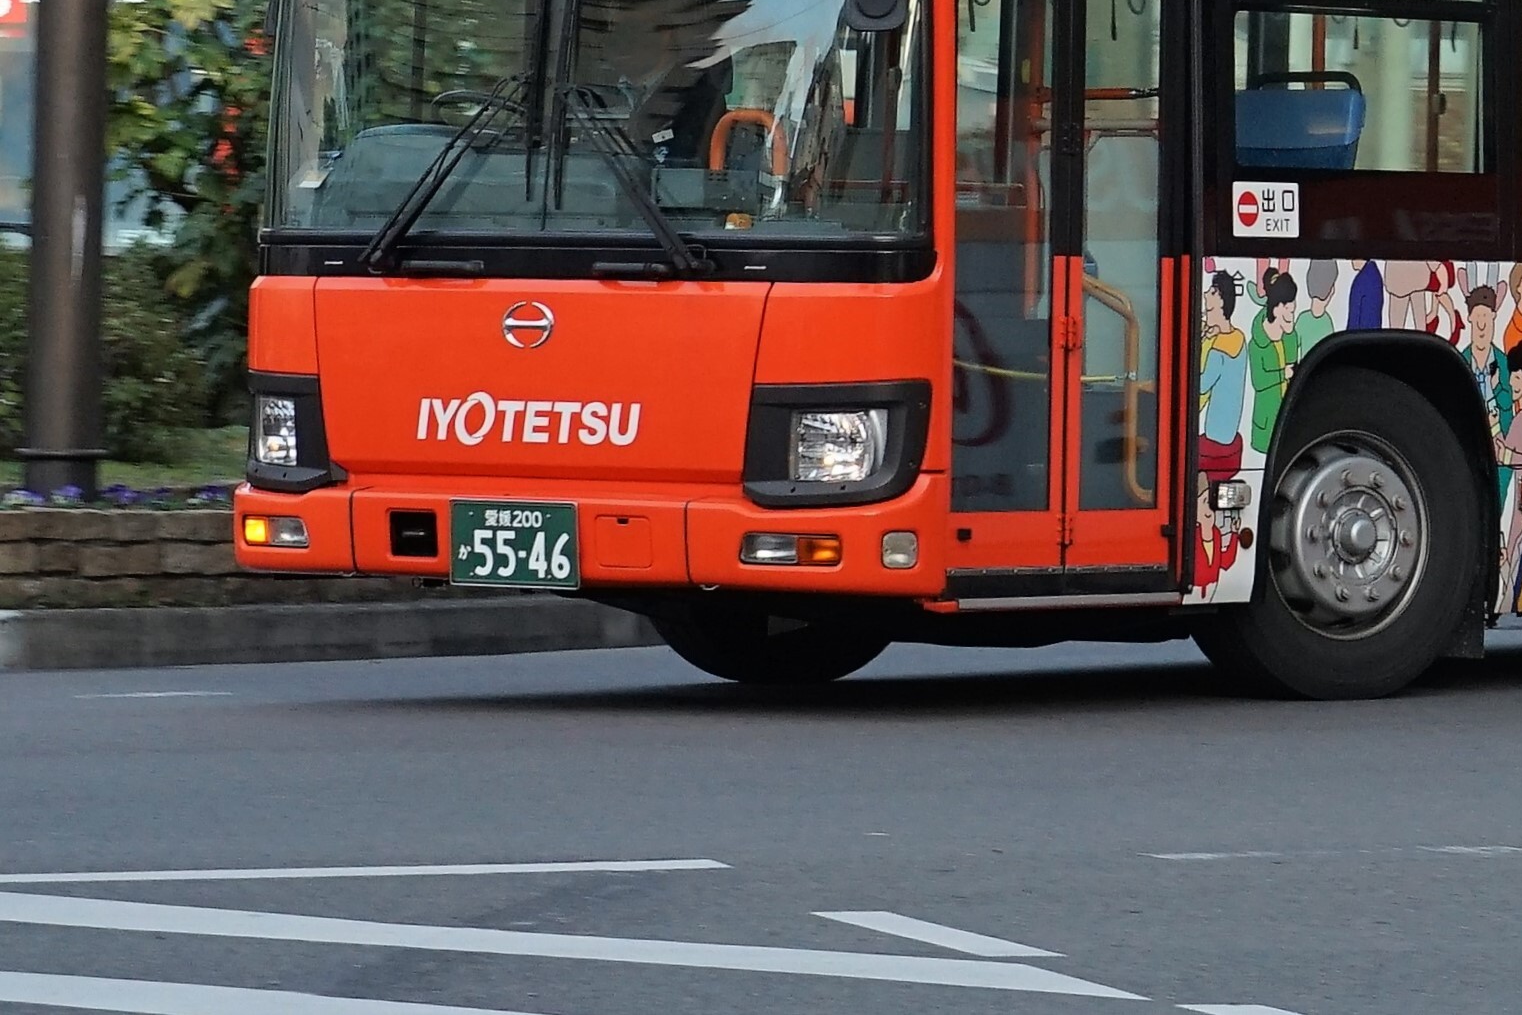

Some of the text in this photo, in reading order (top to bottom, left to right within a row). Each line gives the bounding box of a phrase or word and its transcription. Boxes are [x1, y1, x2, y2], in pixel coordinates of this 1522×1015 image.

[1262, 188, 1295, 212] 出口
[1265, 218, 1290, 232] EXIT
[416, 391, 641, 446] IYOTETSU
[458, 529, 571, 580] か 55-46
